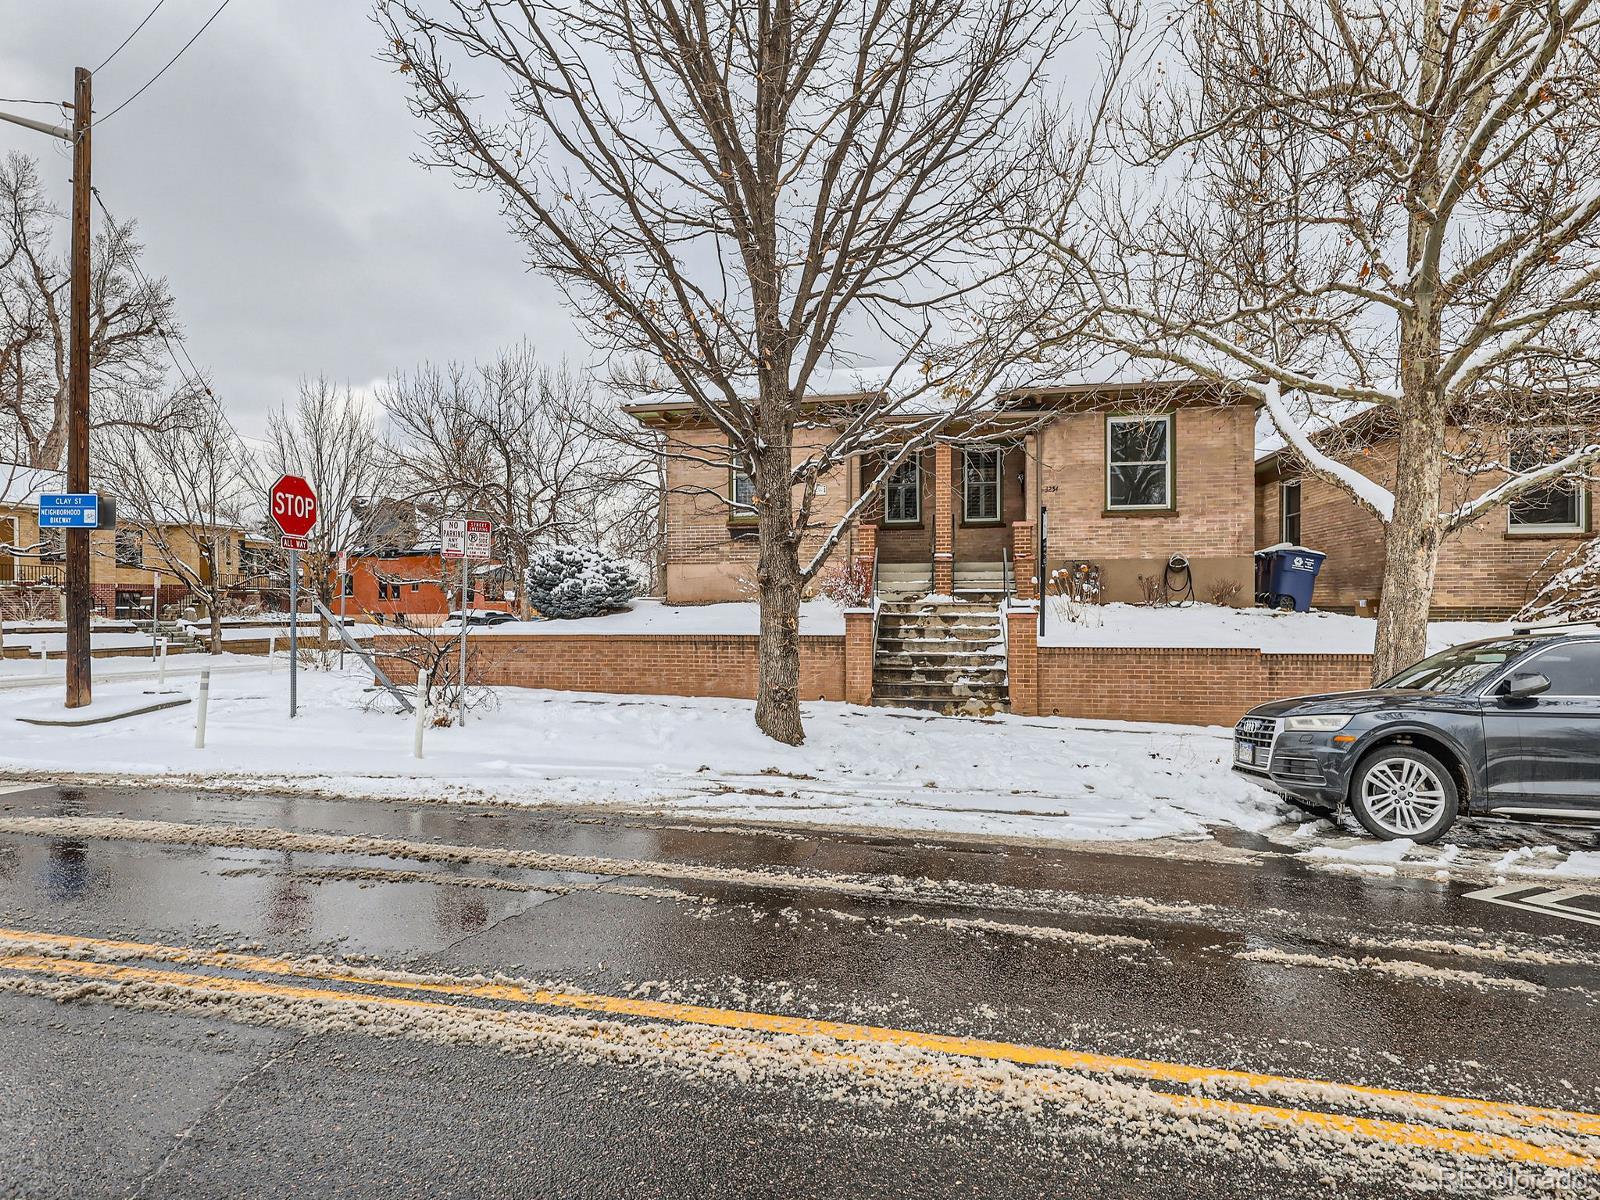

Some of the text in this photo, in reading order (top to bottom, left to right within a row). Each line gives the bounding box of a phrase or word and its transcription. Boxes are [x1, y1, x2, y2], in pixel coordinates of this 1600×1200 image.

[275, 492, 314, 519] STOP
[443, 530, 464, 538] PARKING
[283, 538, 307, 548] ALL WAY
